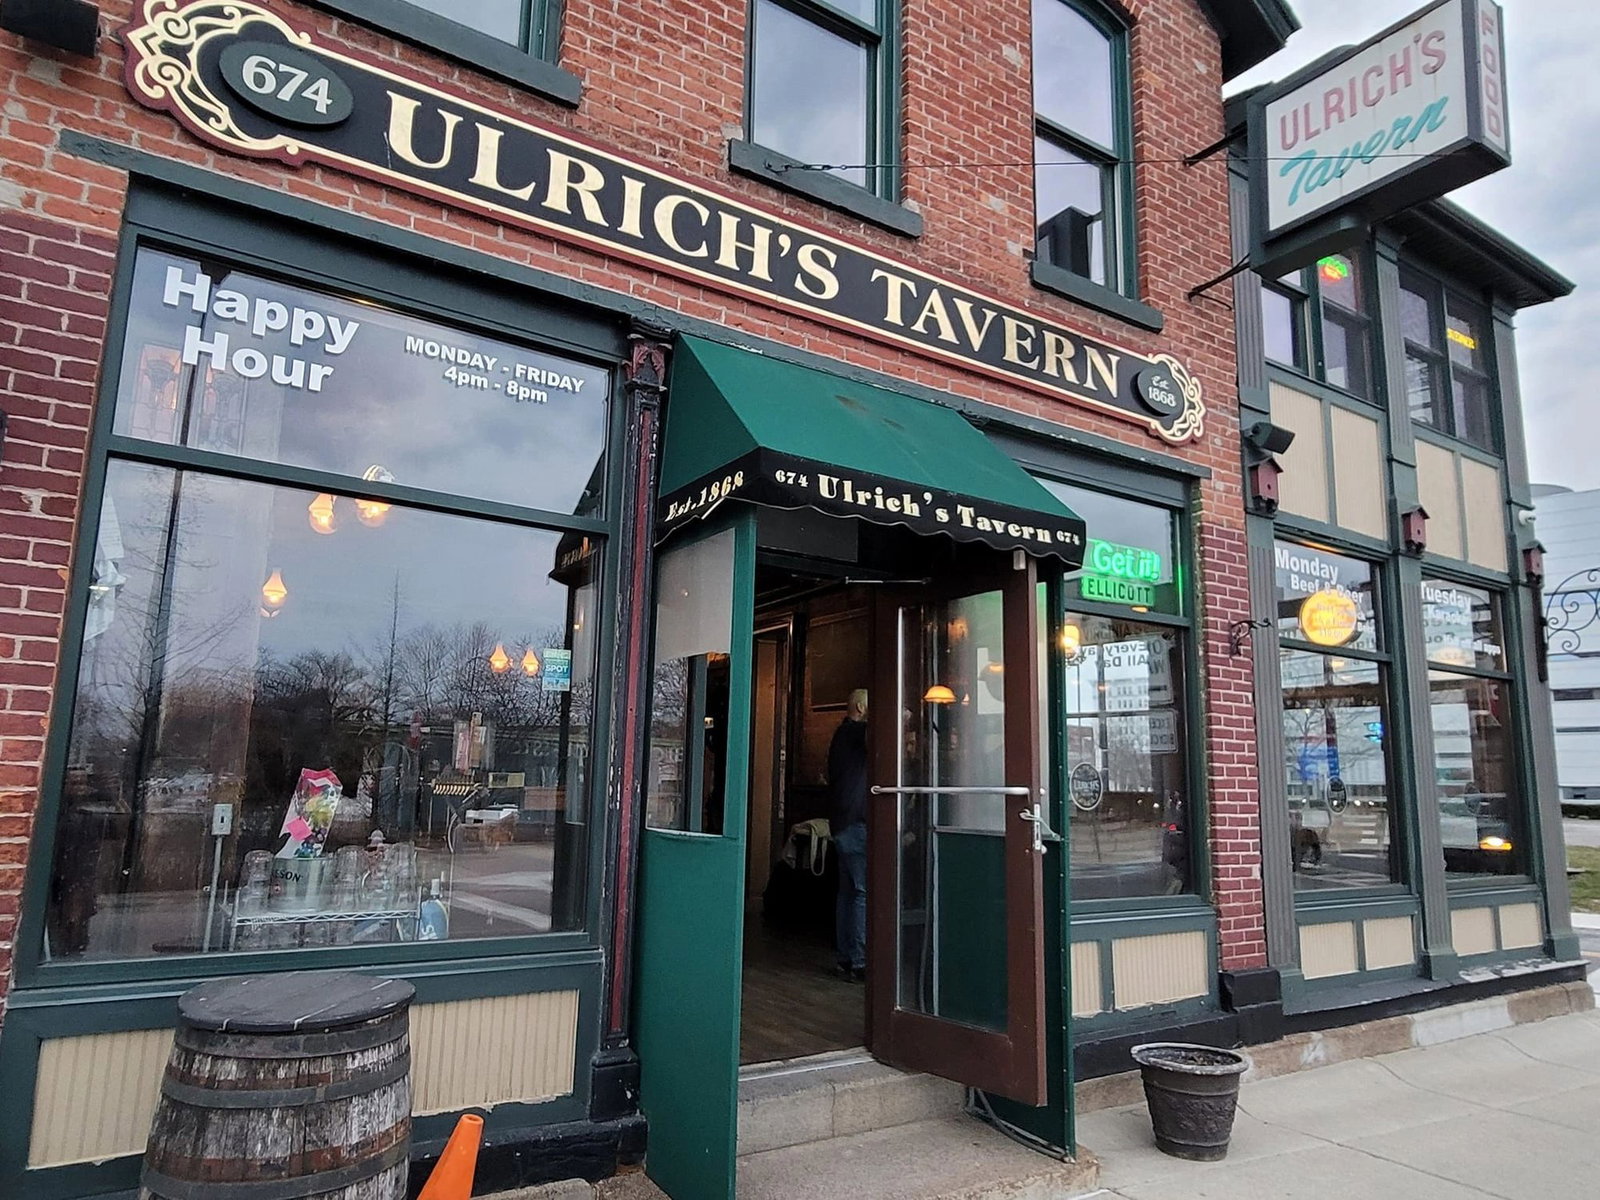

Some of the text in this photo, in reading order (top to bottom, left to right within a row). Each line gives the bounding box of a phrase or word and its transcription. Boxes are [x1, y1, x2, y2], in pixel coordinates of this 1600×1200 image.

[241, 55, 333, 114] 674
[1280, 30, 1446, 151] ULRICH'S
[1481, 10, 1501, 138] FOOD
[1280, 96, 1448, 206] Tavern
[386, 90, 1121, 398] ULRICH'S TAVERN
[163, 266, 360, 354] Happy
[182, 325, 335, 392] Hour
[405, 336, 498, 371] MONDAY
[515, 363, 585, 393] FRIDAY
[444, 366, 488, 388] 4pm
[506, 380, 548, 403] 8pm
[1148, 386, 1177, 407] 1868
[775, 469, 1081, 546] 674 Ulrich's Tavern 674
[1087, 577, 1151, 604] ELLICOTT
[1275, 547, 1339, 585] Monday
[1290, 573, 1320, 594] Beef
[1420, 581, 1471, 613] Tuesday
[545, 664, 568, 673] SPOT
